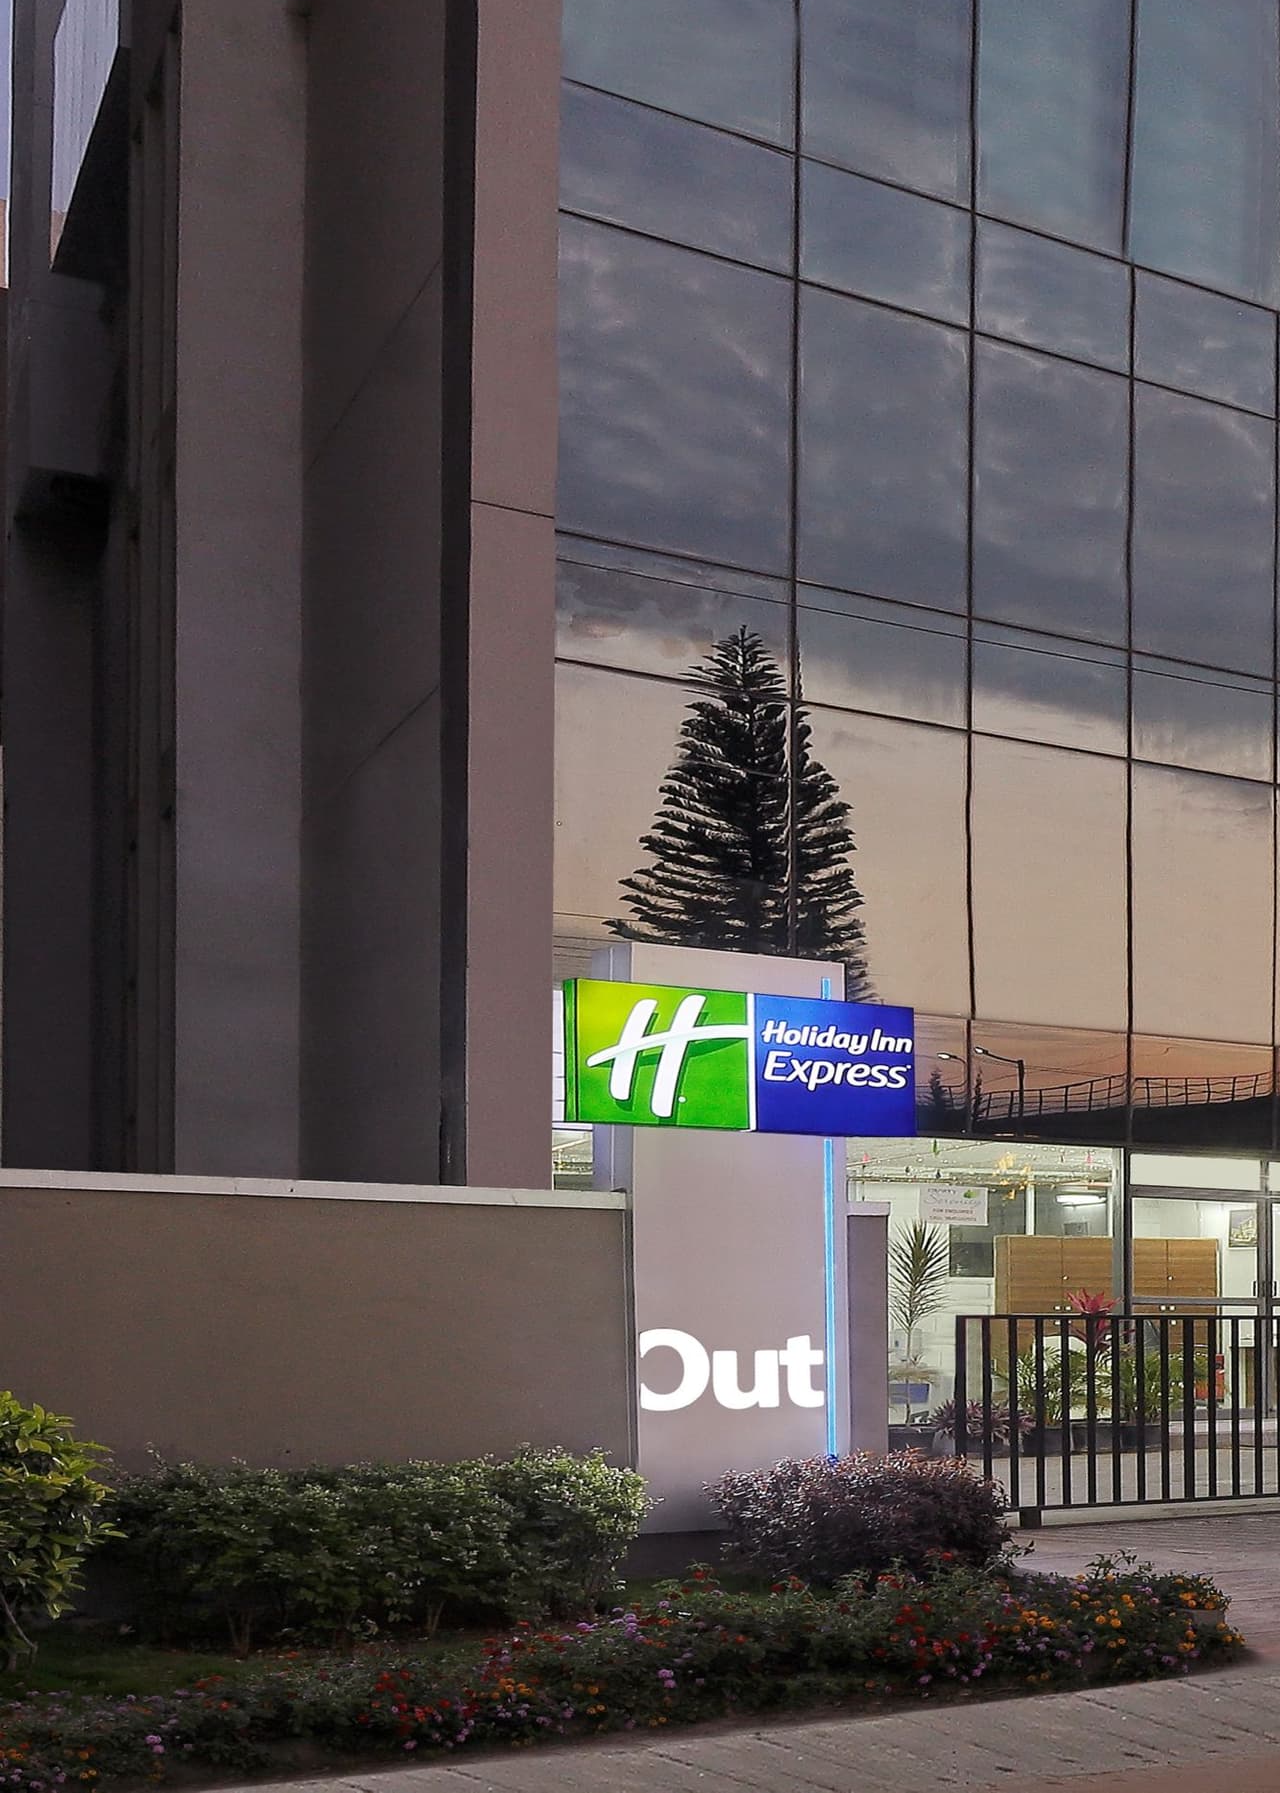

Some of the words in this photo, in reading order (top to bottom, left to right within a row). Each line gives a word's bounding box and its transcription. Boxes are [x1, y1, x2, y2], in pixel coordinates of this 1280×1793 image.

[761, 1019, 868, 1057] Holiday
[869, 1028, 914, 1054] Inn
[762, 1049, 910, 1091] Express
[639, 1327, 825, 1411] Out
